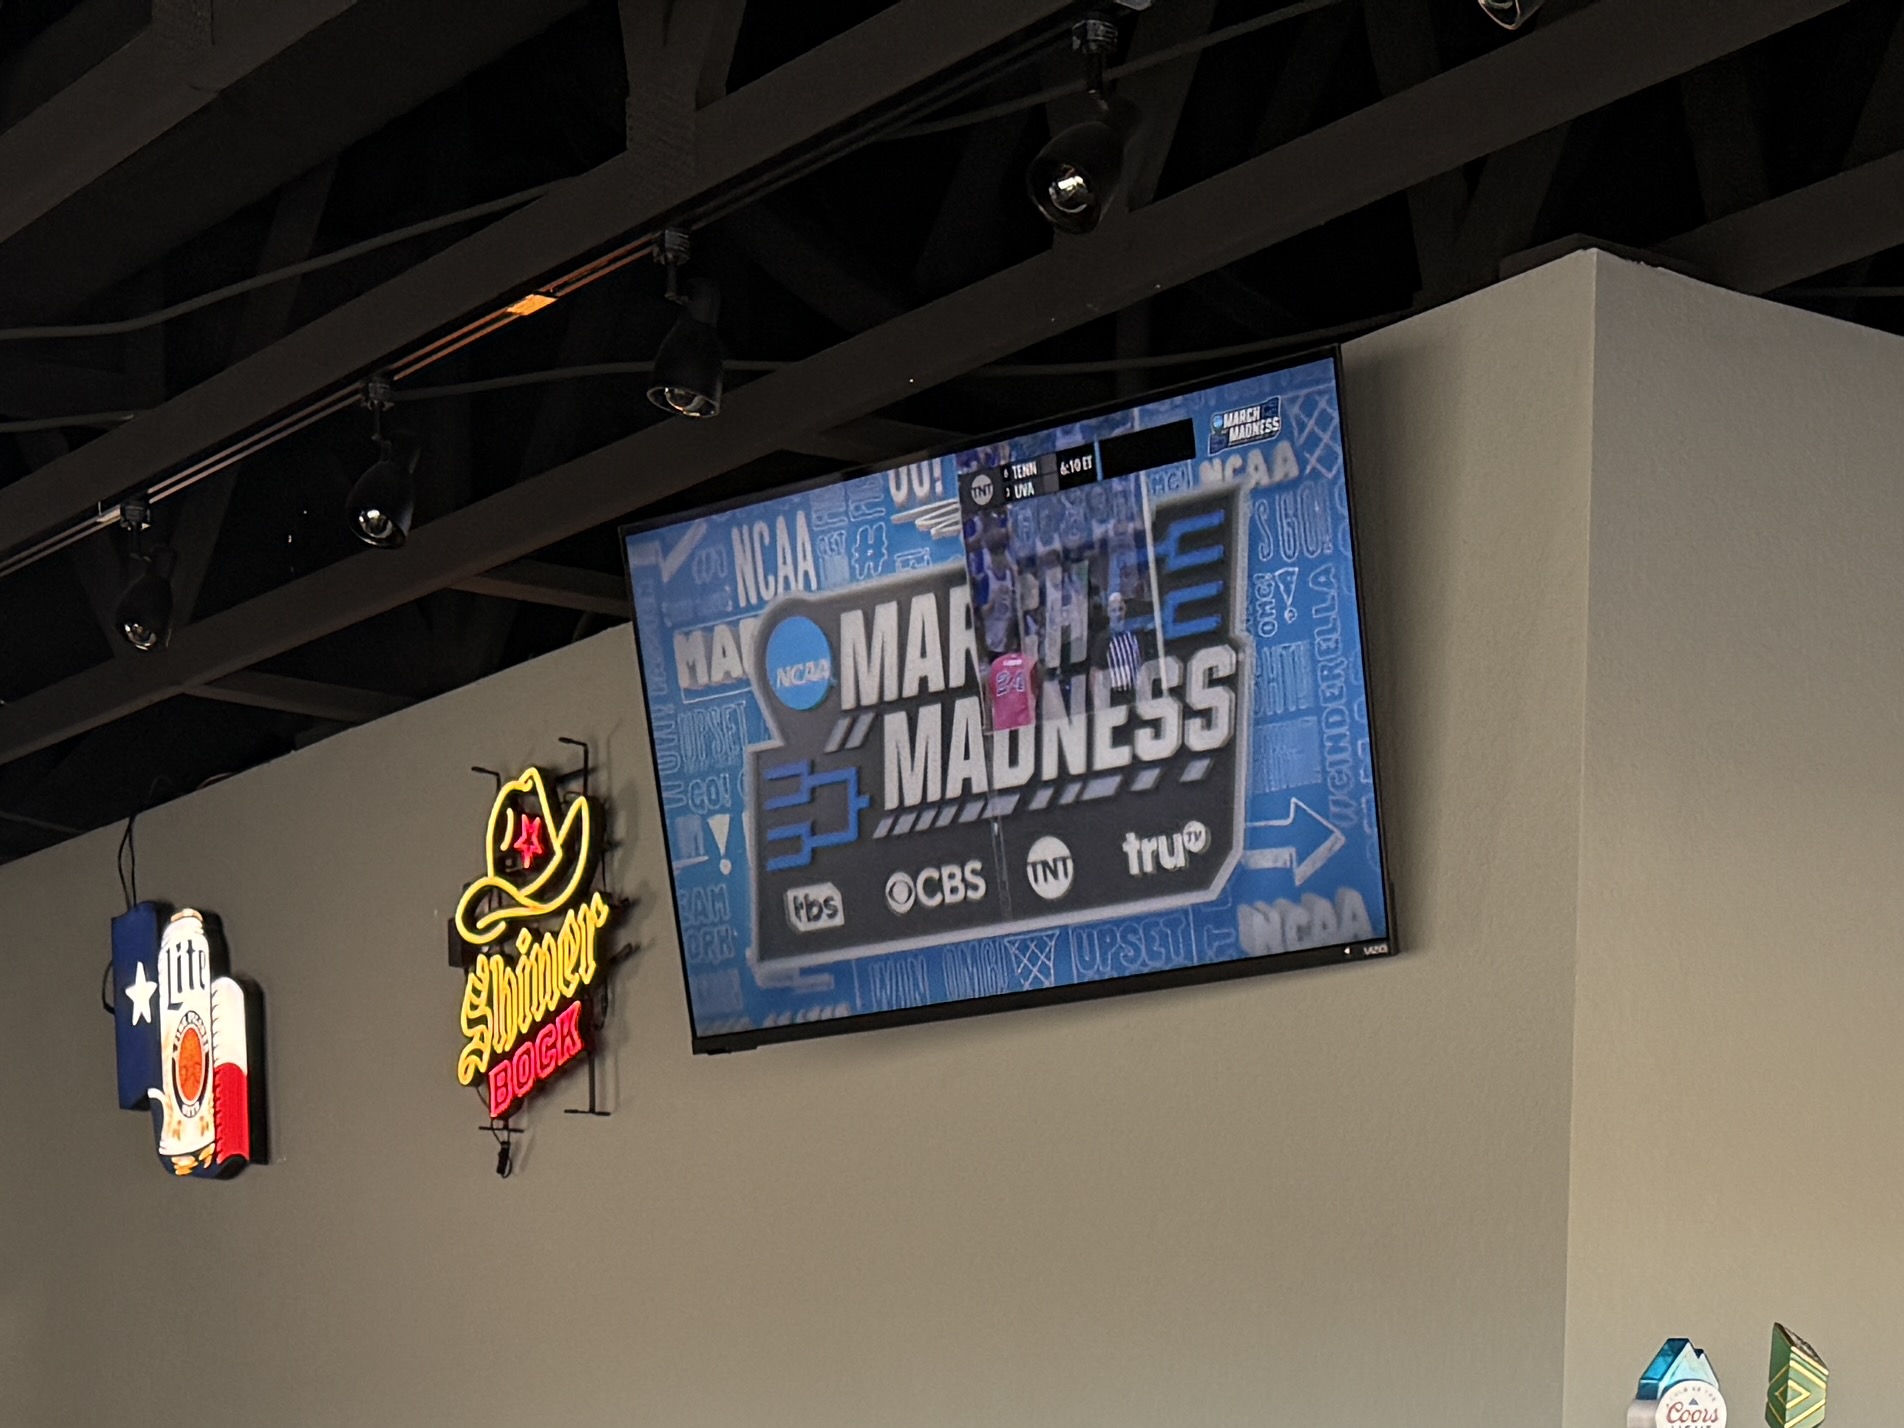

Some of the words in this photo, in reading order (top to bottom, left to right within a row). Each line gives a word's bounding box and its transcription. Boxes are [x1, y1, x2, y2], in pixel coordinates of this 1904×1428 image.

[1222, 405, 1261, 430] MARCH
[1228, 416, 1280, 443] MADNESS
[1011, 460, 1038, 480] TENN
[1082, 454, 1094, 471] ET
[1013, 481, 1035, 500] UVA
[731, 510, 819, 608] NCAA
[776, 659, 832, 689] NCAA
[883, 644, 1237, 811] MADNESS
[916, 859, 988, 908] CBS
[1027, 854, 1074, 885] TNT
[792, 893, 840, 923] tbs
[1238, 887, 1372, 954] NCAA
[166, 939, 207, 1011] Lite
[458, 892, 610, 1087] Shiner
[487, 1000, 585, 1119] BOCK
[1666, 1400, 1720, 1424] Coors
